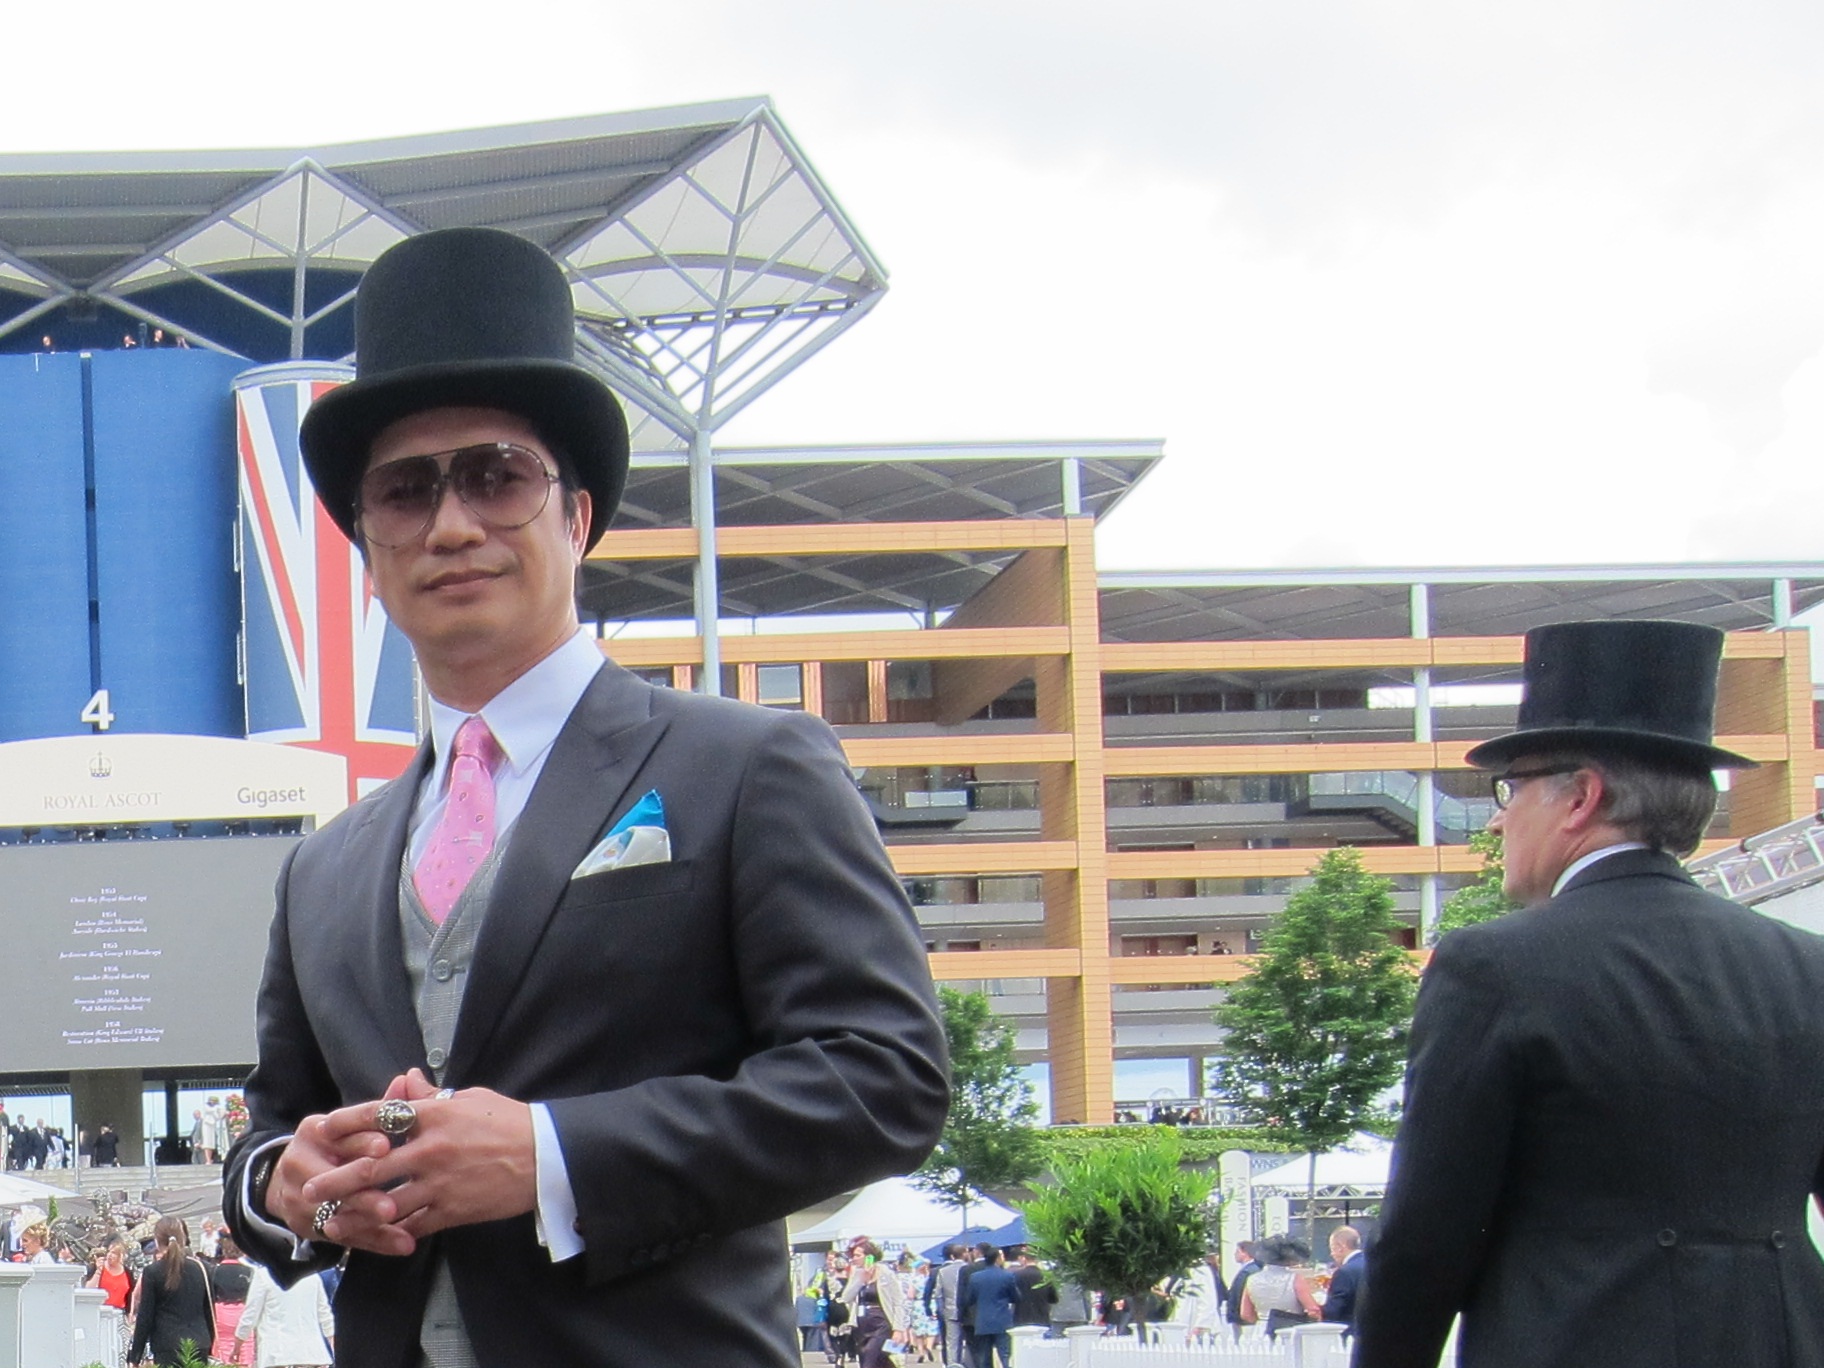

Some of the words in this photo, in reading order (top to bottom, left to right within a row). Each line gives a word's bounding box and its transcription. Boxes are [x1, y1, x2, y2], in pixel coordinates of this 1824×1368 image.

[81, 689, 115, 730] 4
[43, 794, 100, 810] ROYAL
[103, 792, 162, 808] ASCOT
[237, 786, 306, 808] Gigaset
